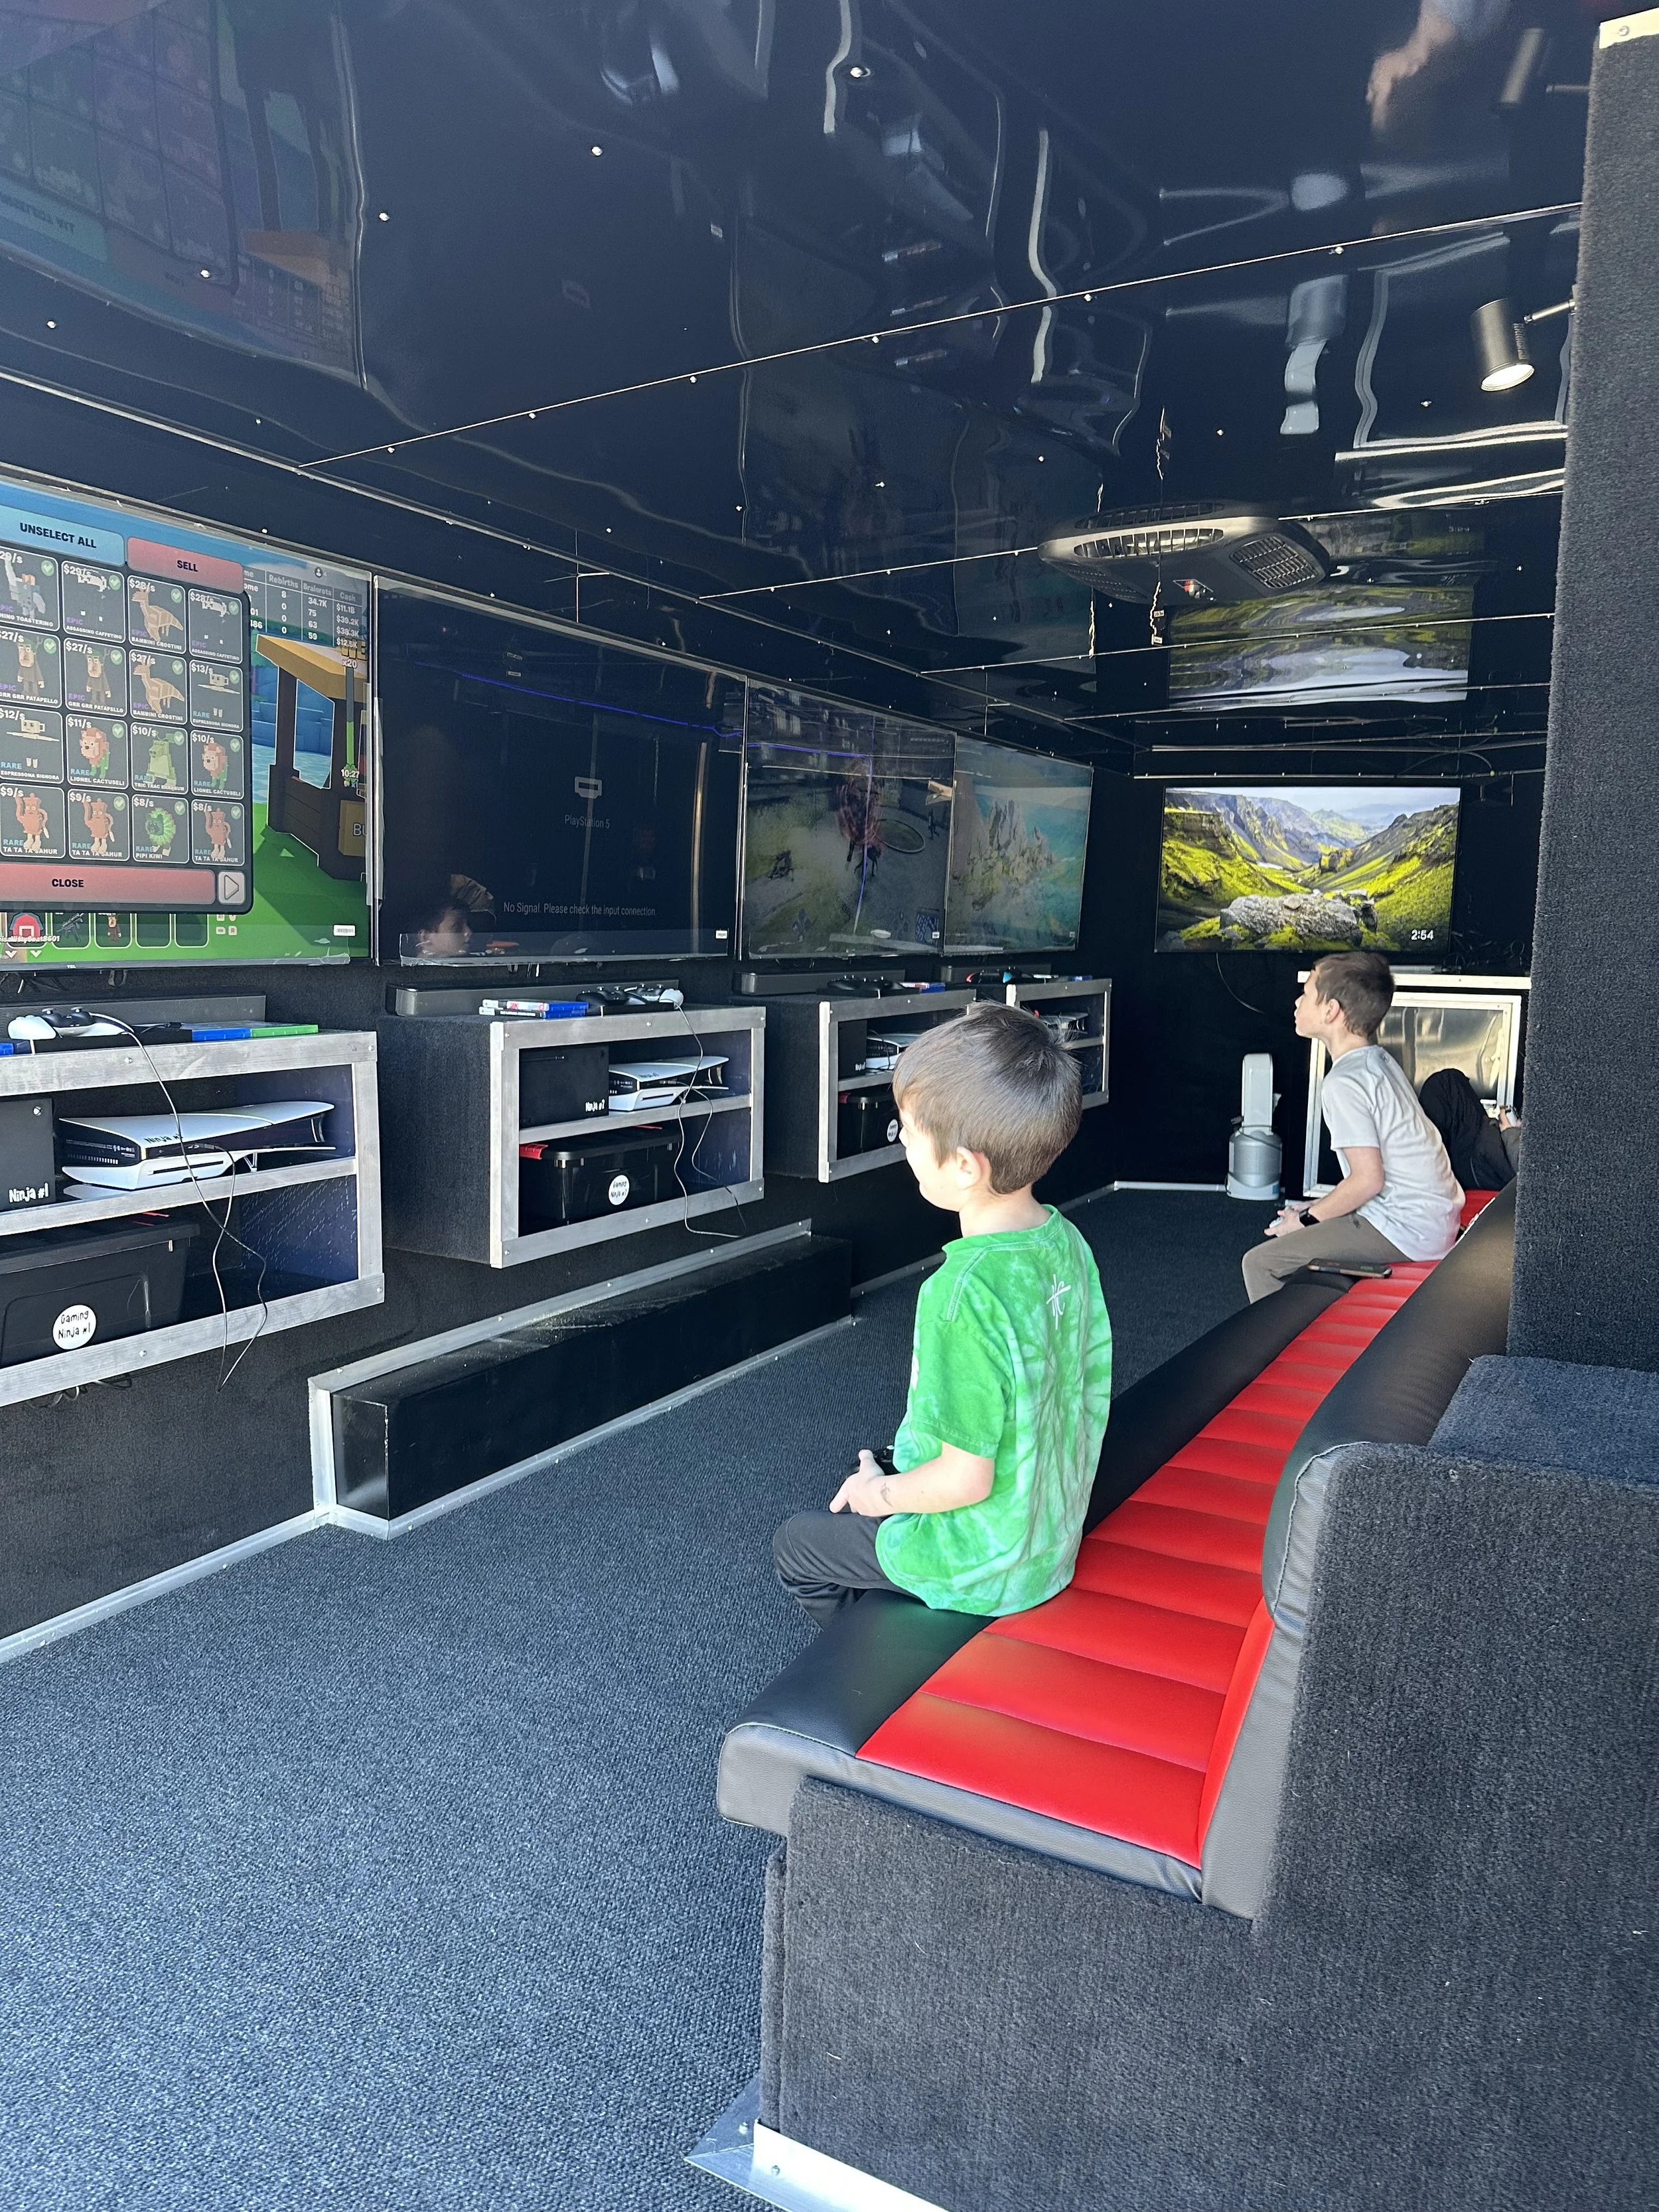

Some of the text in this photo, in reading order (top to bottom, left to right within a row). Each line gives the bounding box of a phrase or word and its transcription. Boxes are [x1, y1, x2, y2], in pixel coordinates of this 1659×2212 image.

[20, 522, 96, 548] UNSELECT ALL
[177, 560, 198, 572] SELL
[269, 575, 299, 588] Rebirths
[303, 583, 332, 596] Brainrots
[340, 592, 356, 602] Cash
[308, 597, 327, 608] 34.7K
[336, 603, 355, 614] $11.1B
[67, 616, 84, 625] EPIC
[336, 614, 359, 627] $39.2K
[308, 632, 317, 640] 59
[66, 641, 92, 654] $27/s
[131, 636, 182, 650] BAMBINI CROSTINI
[191, 663, 214, 674] $13/s
[68, 717, 92, 729] $11/s
[133, 725, 157, 737] $10/s
[192, 733, 214, 743] $10/s
[341, 769, 360, 778] 10:27
[1, 786, 24, 798] $9/s
[70, 792, 92, 802] $9/s
[134, 797, 154, 808] $8/s
[193, 802, 212, 812] $8/s
[565, 814, 610, 829] PlayStation 5
[52, 879, 84, 887] CLOSE
[504, 902, 657, 917] No Signal. Please check the input connection.
[1411, 929, 1433, 940] 2:54
[9, 1183, 49, 1203] Ninja #1
[61, 1311, 88, 1324] Gaming
[58, 1327, 79, 1339] Ninja
